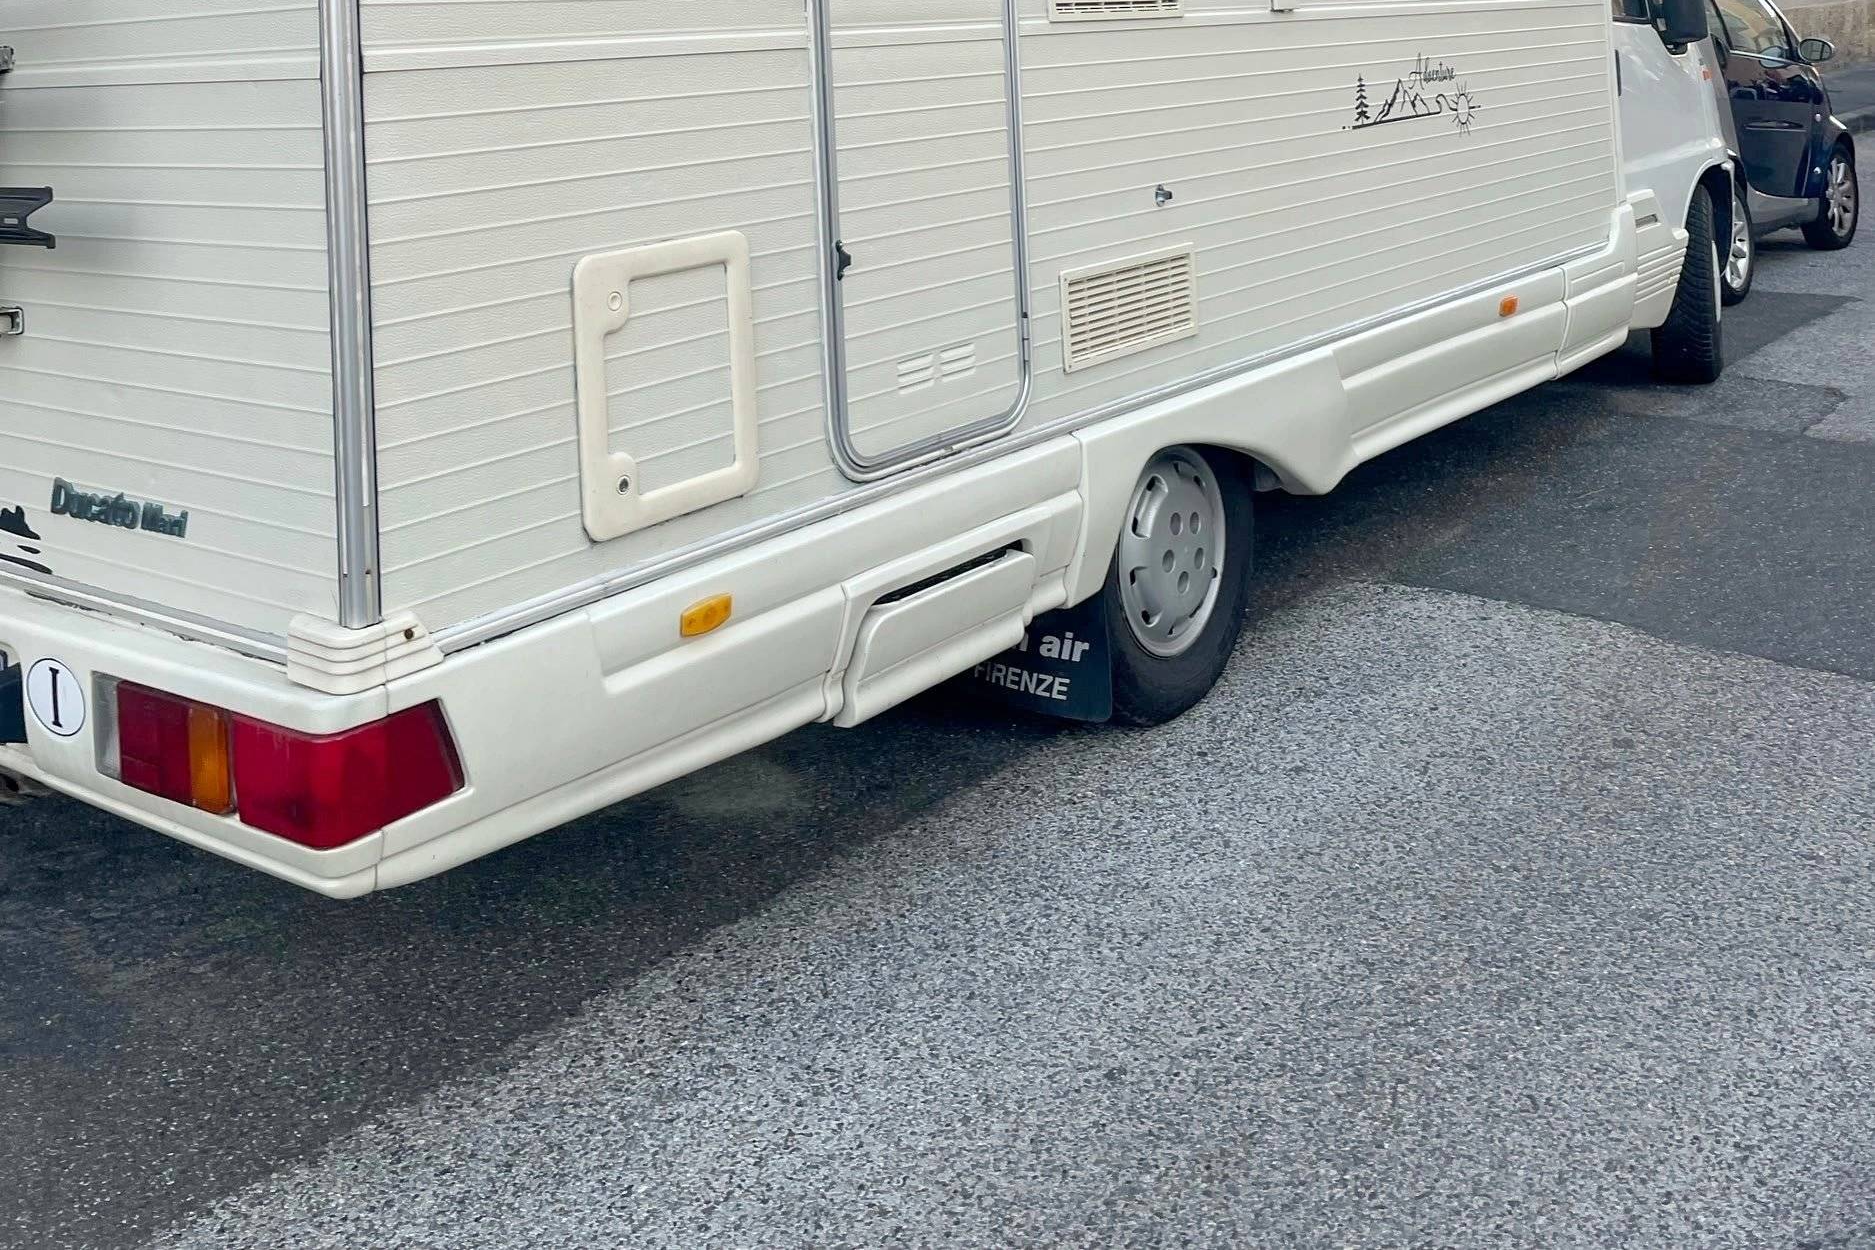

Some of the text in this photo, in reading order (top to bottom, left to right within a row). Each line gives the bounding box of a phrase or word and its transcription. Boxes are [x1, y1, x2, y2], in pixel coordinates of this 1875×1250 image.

[50, 477, 140, 530] Ducato
[1039, 631, 1090, 662] air
[48, 666, 63, 729] I
[973, 661, 1071, 701] FIRENZE
